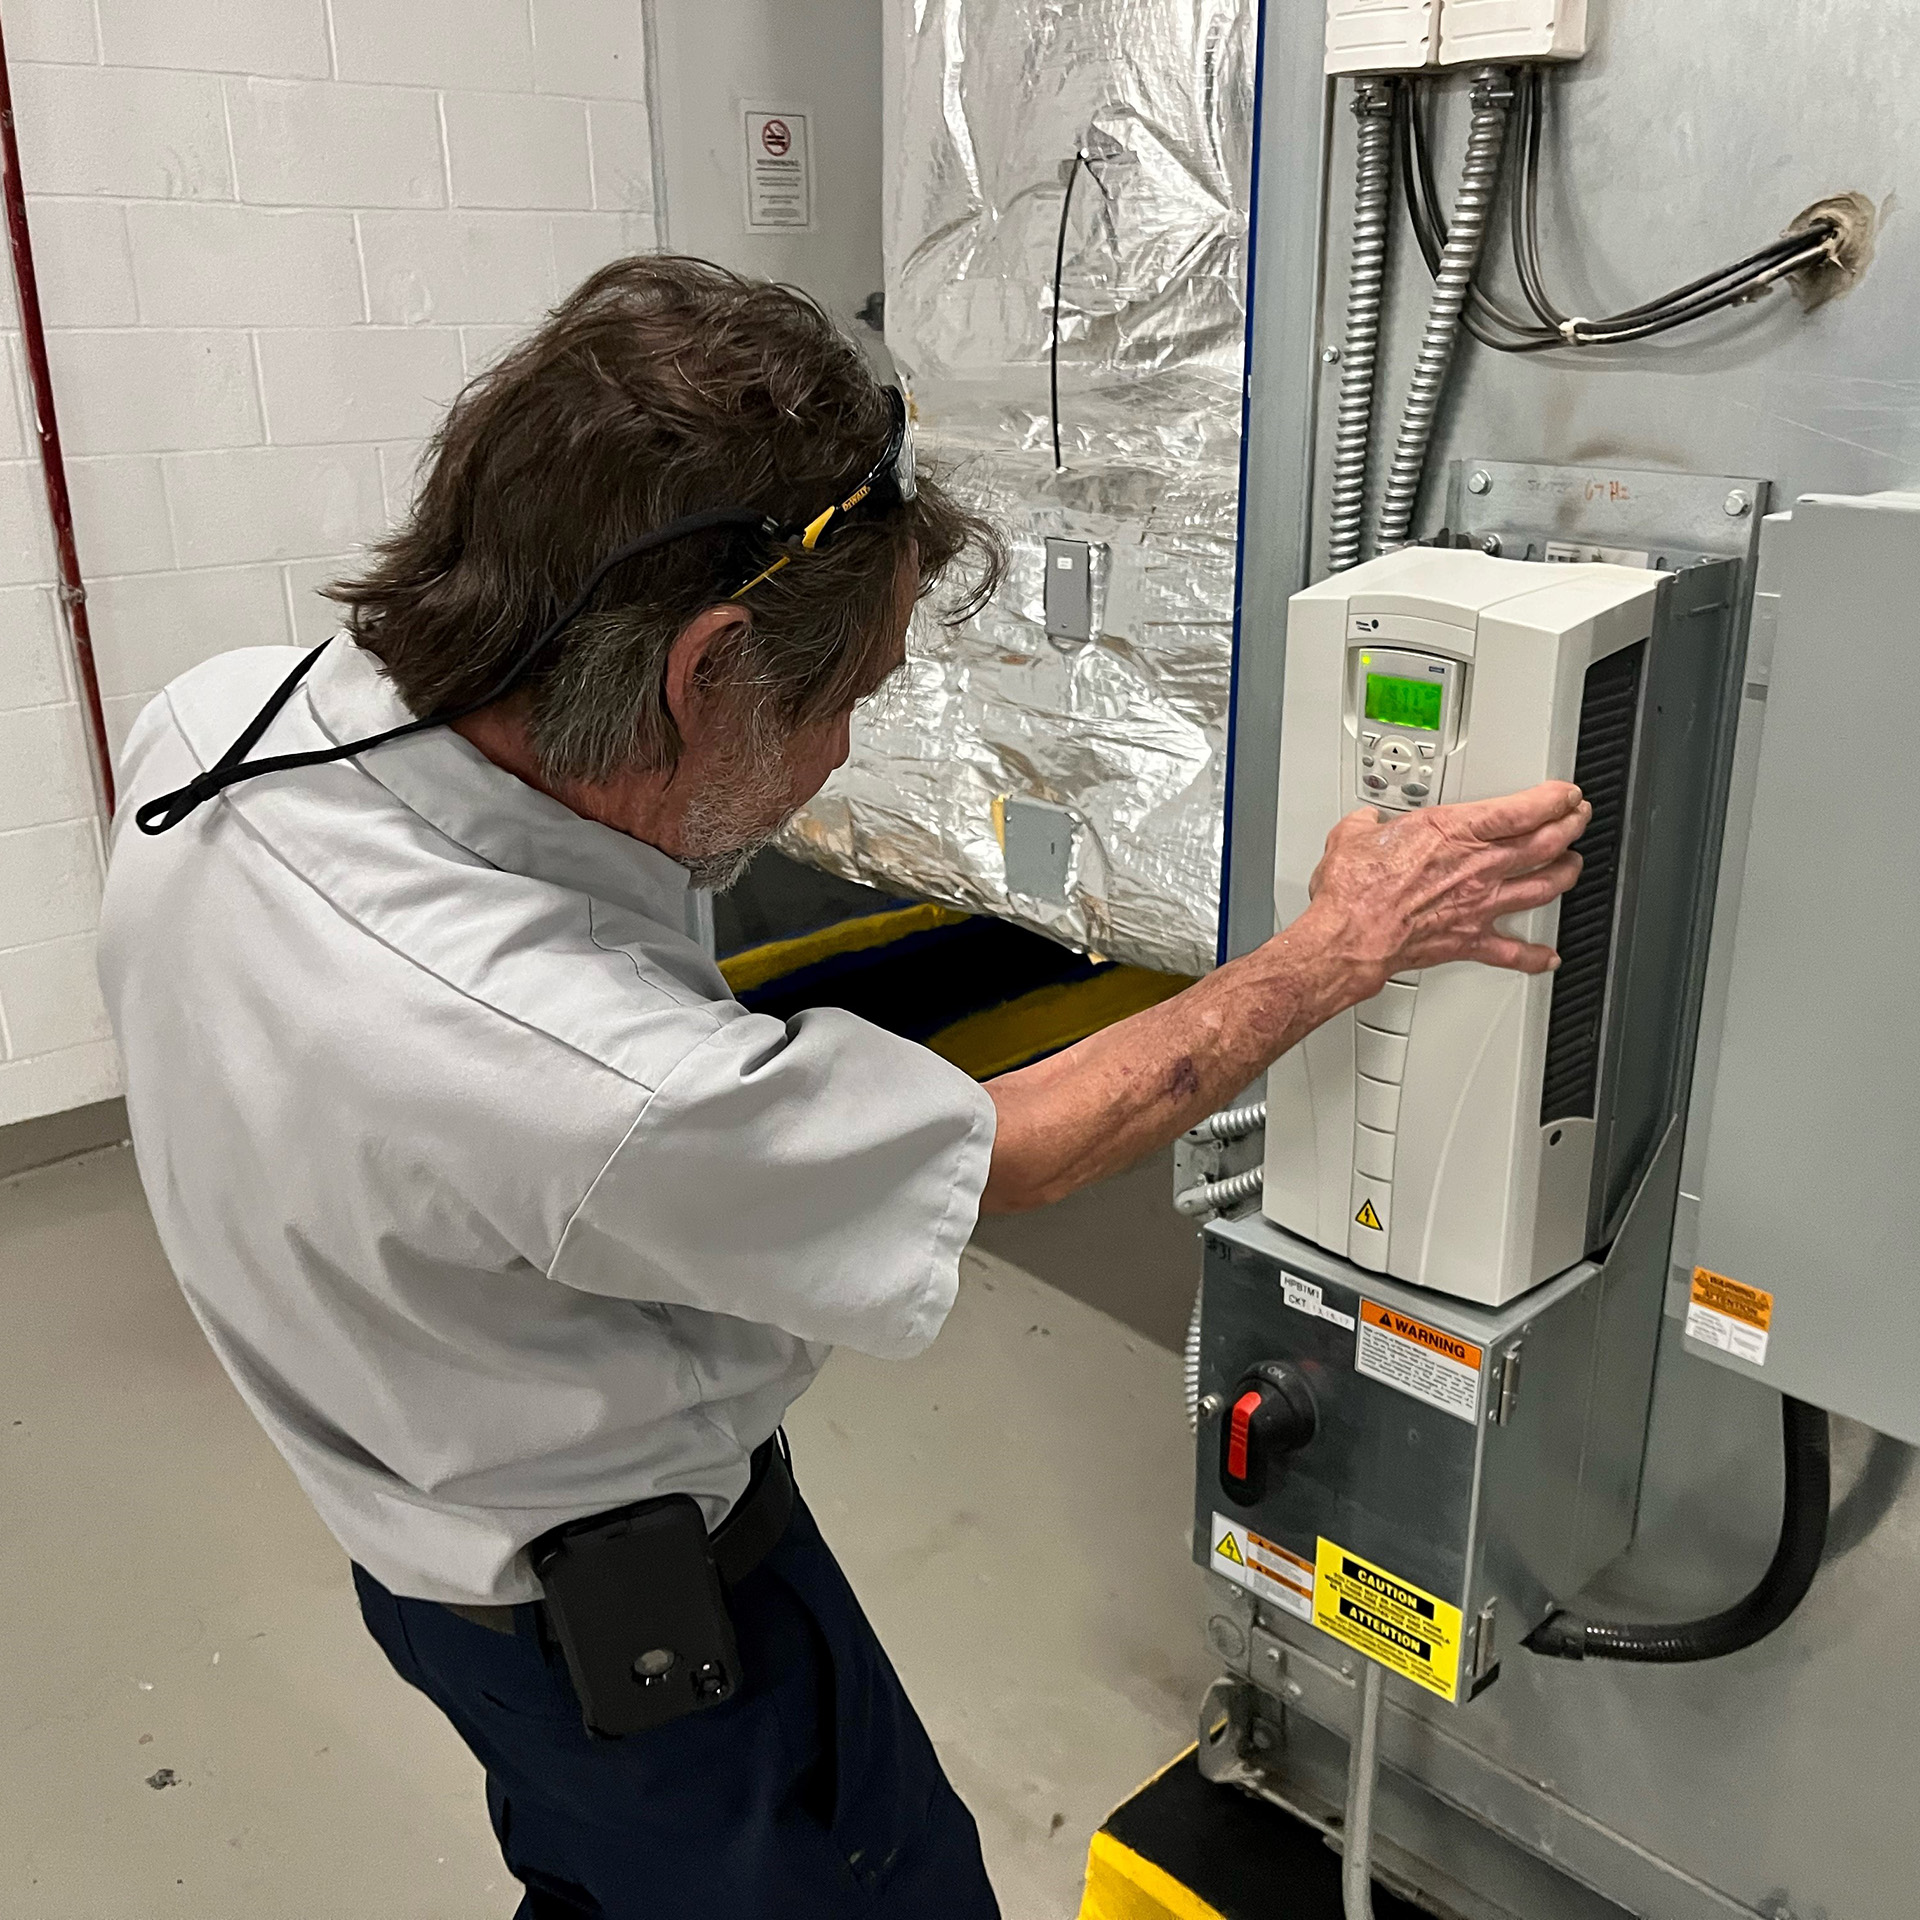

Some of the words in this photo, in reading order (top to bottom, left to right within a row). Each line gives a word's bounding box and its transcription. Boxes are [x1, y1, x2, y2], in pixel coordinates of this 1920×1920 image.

[1288, 1294, 1307, 1308] CKT
[1395, 1317, 1465, 1359] WARNING
[1267, 1366, 1286, 1379] ON
[1357, 1569, 1418, 1610] CAUTION
[1349, 1606, 1421, 1654] ATTENTION
